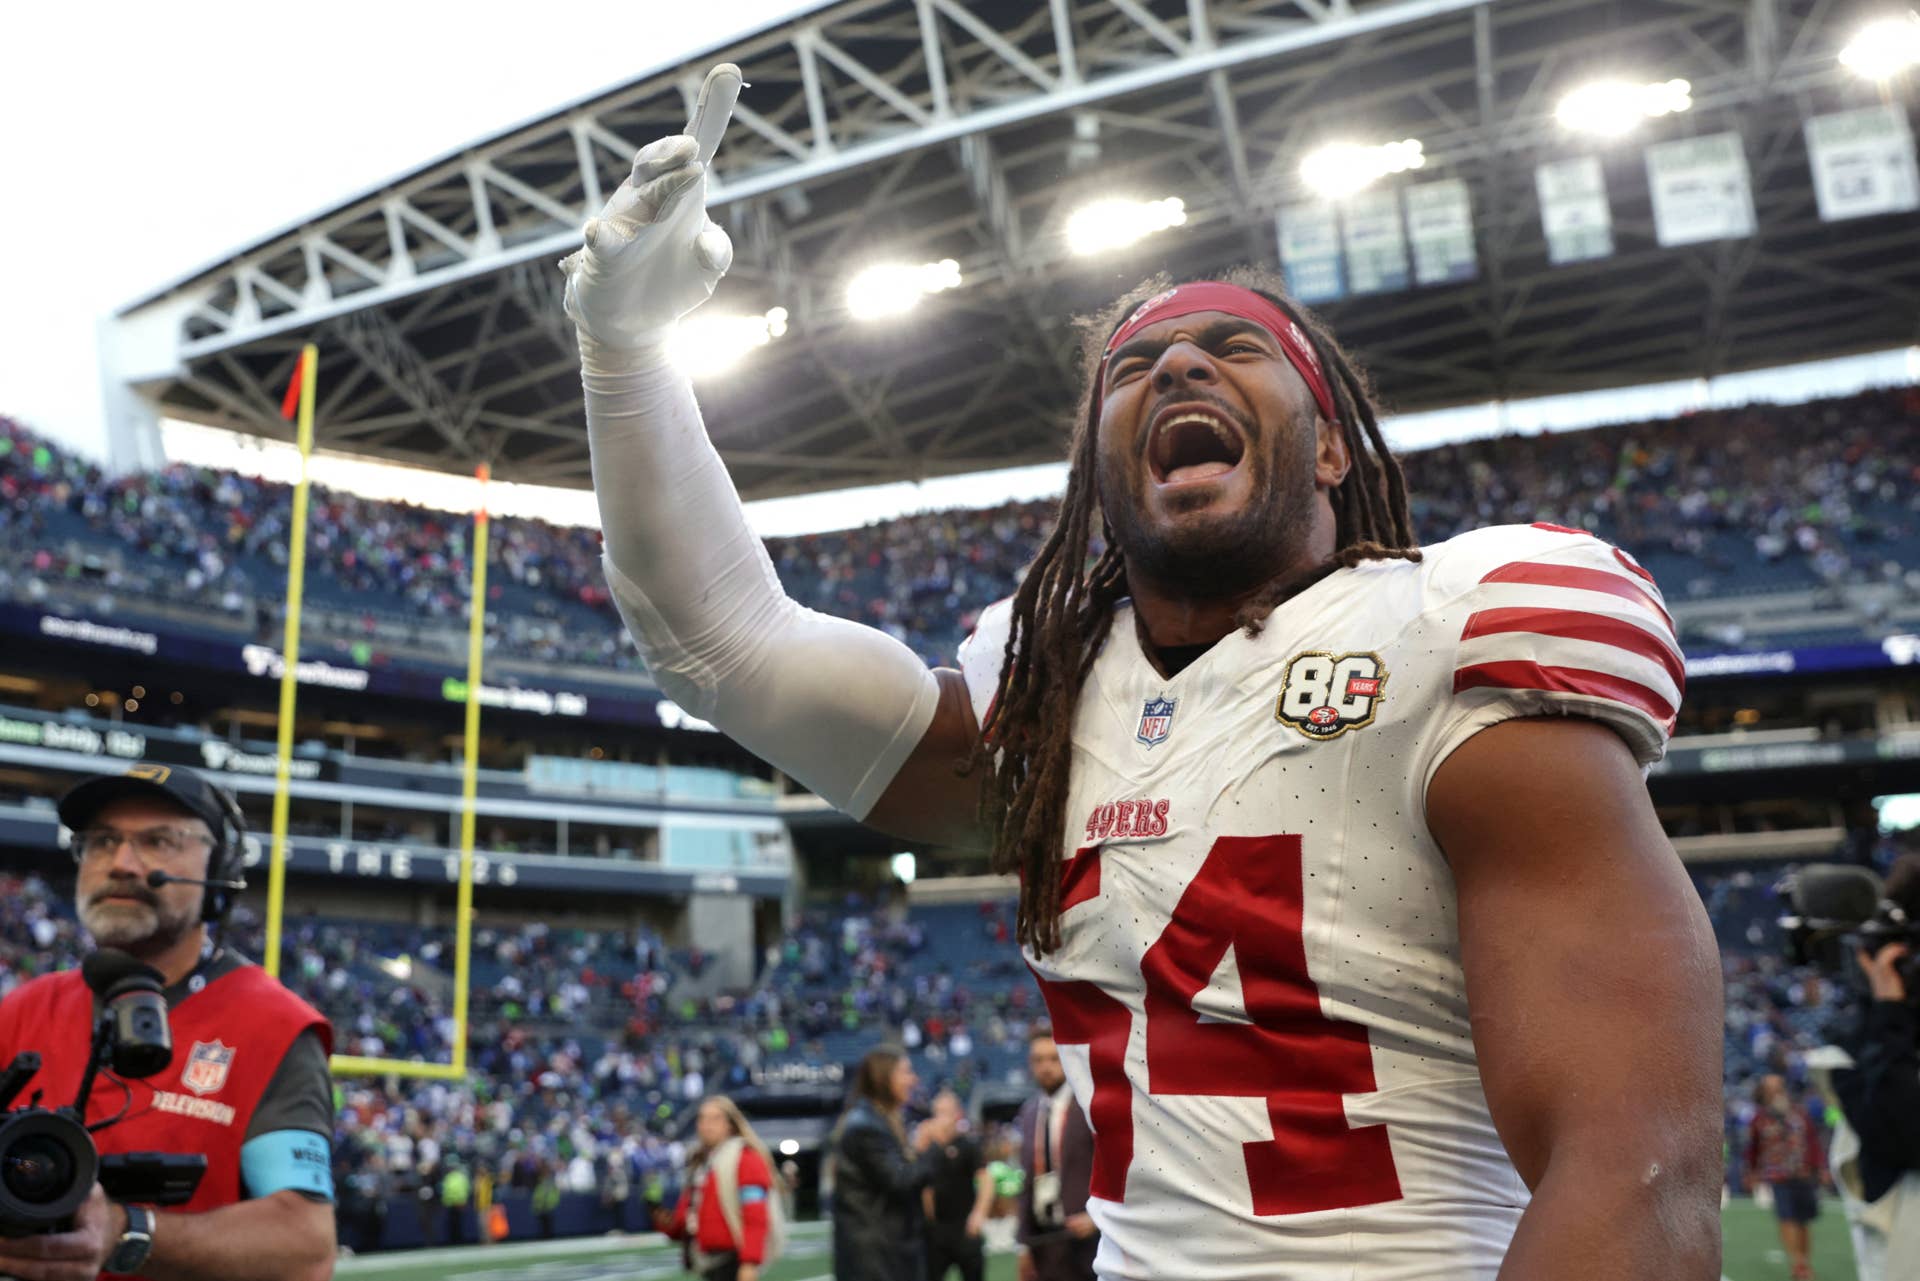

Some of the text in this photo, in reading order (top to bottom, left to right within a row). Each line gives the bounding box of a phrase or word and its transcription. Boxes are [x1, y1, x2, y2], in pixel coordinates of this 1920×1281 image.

[1351, 681, 1375, 694] YEARS
[1141, 717, 1167, 738] NFL
[1321, 725, 1338, 733] 1946
[1085, 798, 1170, 841] 49ERS
[326, 842, 413, 879] THE
[151, 1090, 236, 1127] TELEVISION
